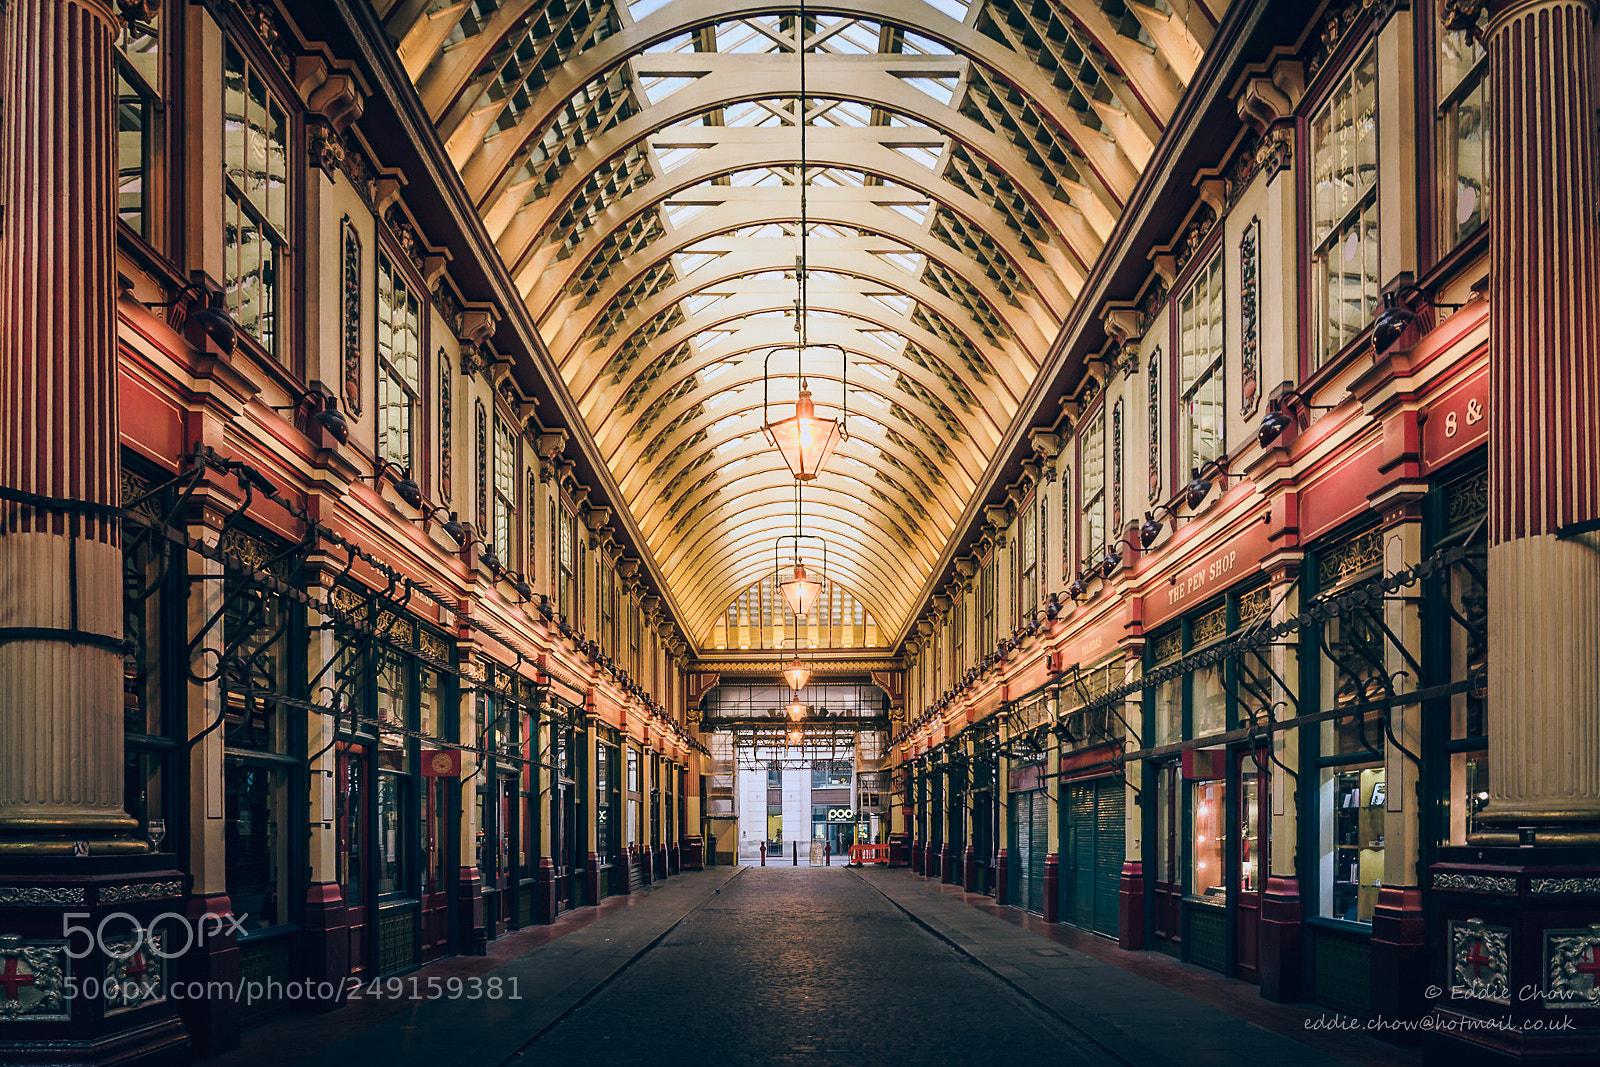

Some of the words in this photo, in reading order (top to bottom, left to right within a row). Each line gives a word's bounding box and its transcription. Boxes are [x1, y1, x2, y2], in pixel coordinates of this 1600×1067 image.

[1445, 411, 1457, 438] 8
[1466, 398, 1484, 425] &
[1168, 582, 1185, 605] THE
[1187, 569, 1206, 594] PEN
[1209, 550, 1236, 581] SHOP
